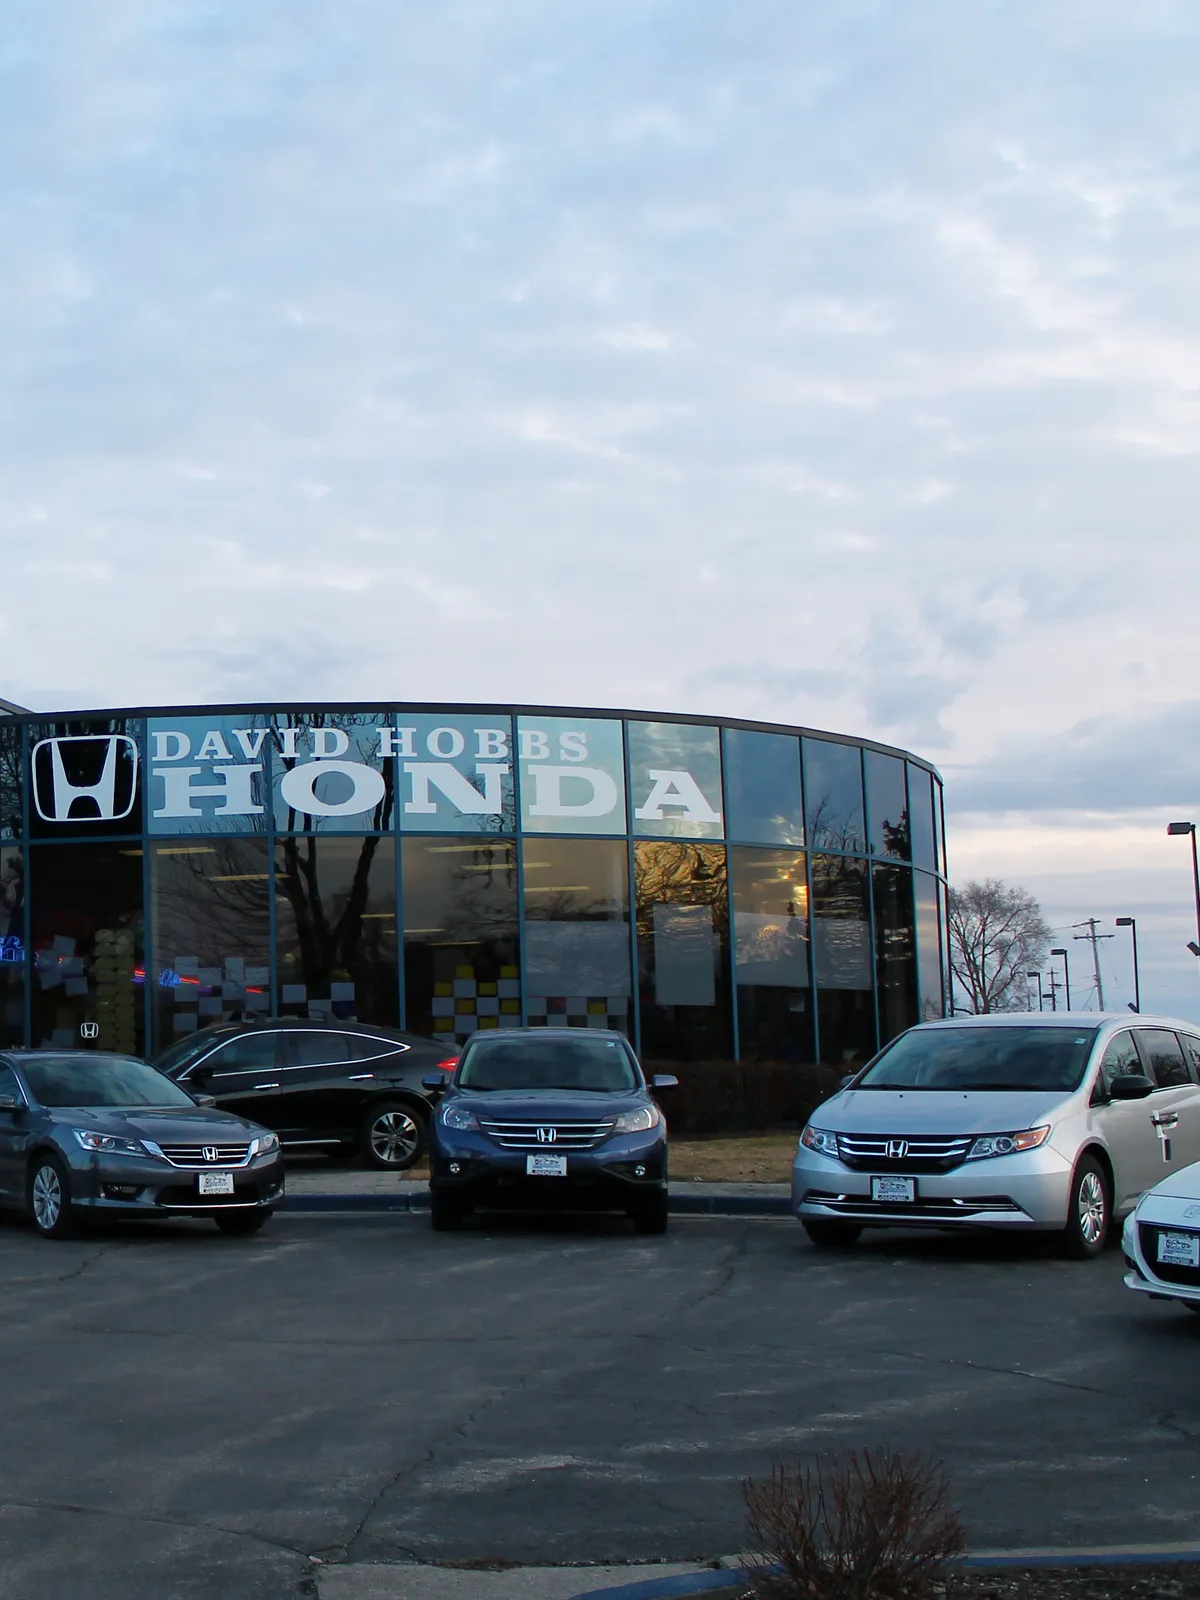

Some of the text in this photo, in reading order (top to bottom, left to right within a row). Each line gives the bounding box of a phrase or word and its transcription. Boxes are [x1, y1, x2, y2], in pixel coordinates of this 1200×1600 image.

[151, 727, 589, 762] DAVID HOBBS
[152, 760, 722, 823] HONDA
